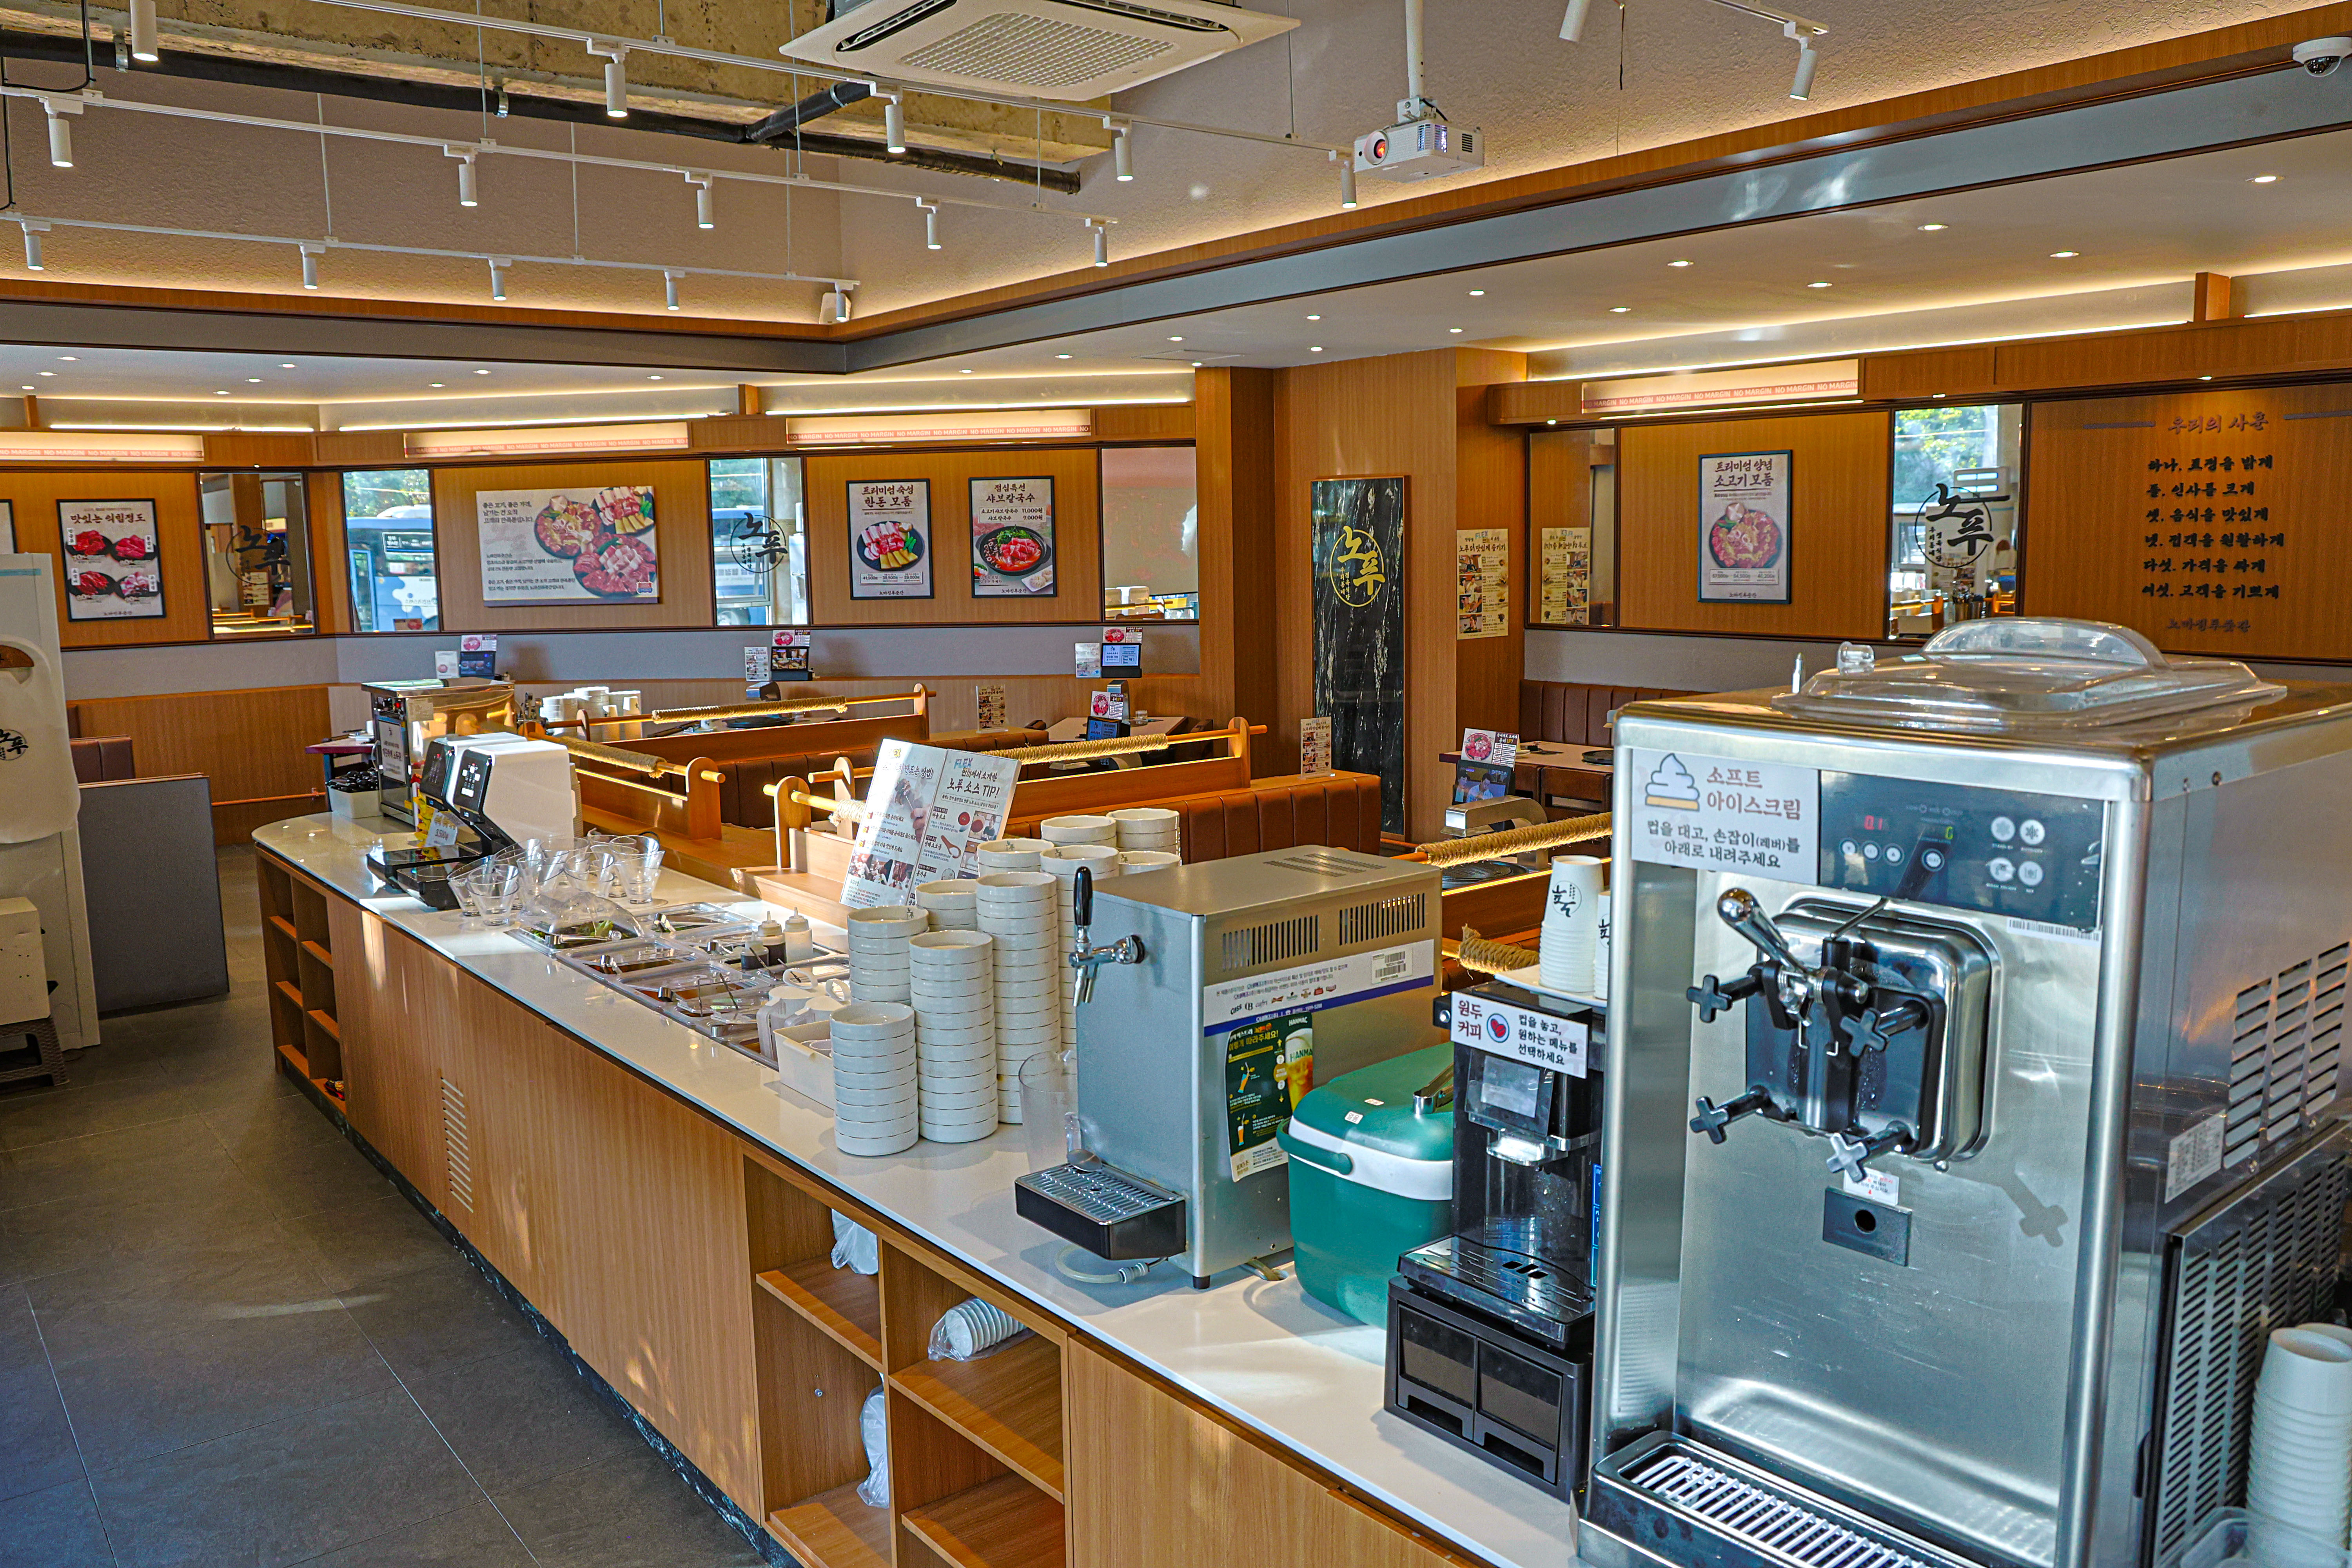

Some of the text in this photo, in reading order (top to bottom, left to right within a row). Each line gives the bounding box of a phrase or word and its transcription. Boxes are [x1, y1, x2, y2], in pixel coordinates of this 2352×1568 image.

[2168, 411, 2269, 434] 우리의 사훈
[1715, 458, 1773, 472] 프리미엄 양념
[2148, 454, 2274, 472] 하나. 표정을 밝게
[995, 483, 1025, 492] 점심특선
[1713, 472, 1774, 487] 소고기 모둠
[861, 484, 914, 495] 프리미엄 숙성
[2146, 481, 2255, 498] 둘. 인사를 크게
[864, 496, 912, 508] 한돈 모둠
[986, 493, 1035, 503] 샤브칼국수
[70, 513, 146, 524] 맛있는 익힘정도
[2146, 506, 2269, 523] 셋. 음식을 맛있게
[1475, 544, 1490, 552] 맛있게
[1492, 543, 1506, 552] 즐기기
[2145, 533, 2163, 548] 넷.
[2143, 558, 2265, 573] 다섯. 가격을 싸게
[2179, 583, 2227, 599] 고객을
[2232, 584, 2279, 600] 기쁘게
[954, 757, 973, 769] FLEX
[904, 764, 935, 779] 만드는 방법!
[981, 771, 998, 782] 소개한
[1707, 766, 1763, 789] 소프트
[947, 778, 1000, 799] 노푸 소스 TIP!
[1707, 790, 1801, 821] 아이스크림
[1647, 820, 1800, 853] 컵을 대고, 손잡이(레버)를
[1664, 840, 1781, 868] 아래로 내려주세요
[1458, 1000, 1483, 1020] 원두
[1289, 1016, 1308, 1026] HANMAC
[1518, 1014, 1562, 1036] 컵을 놓고,
[1246, 1029, 1279, 1045] 따라주세요!
[1458, 1021, 1481, 1040] 커피
[1518, 1028, 1578, 1055] 원하는 메뉴를
[1518, 1044, 1566, 1065] 선택하세요
